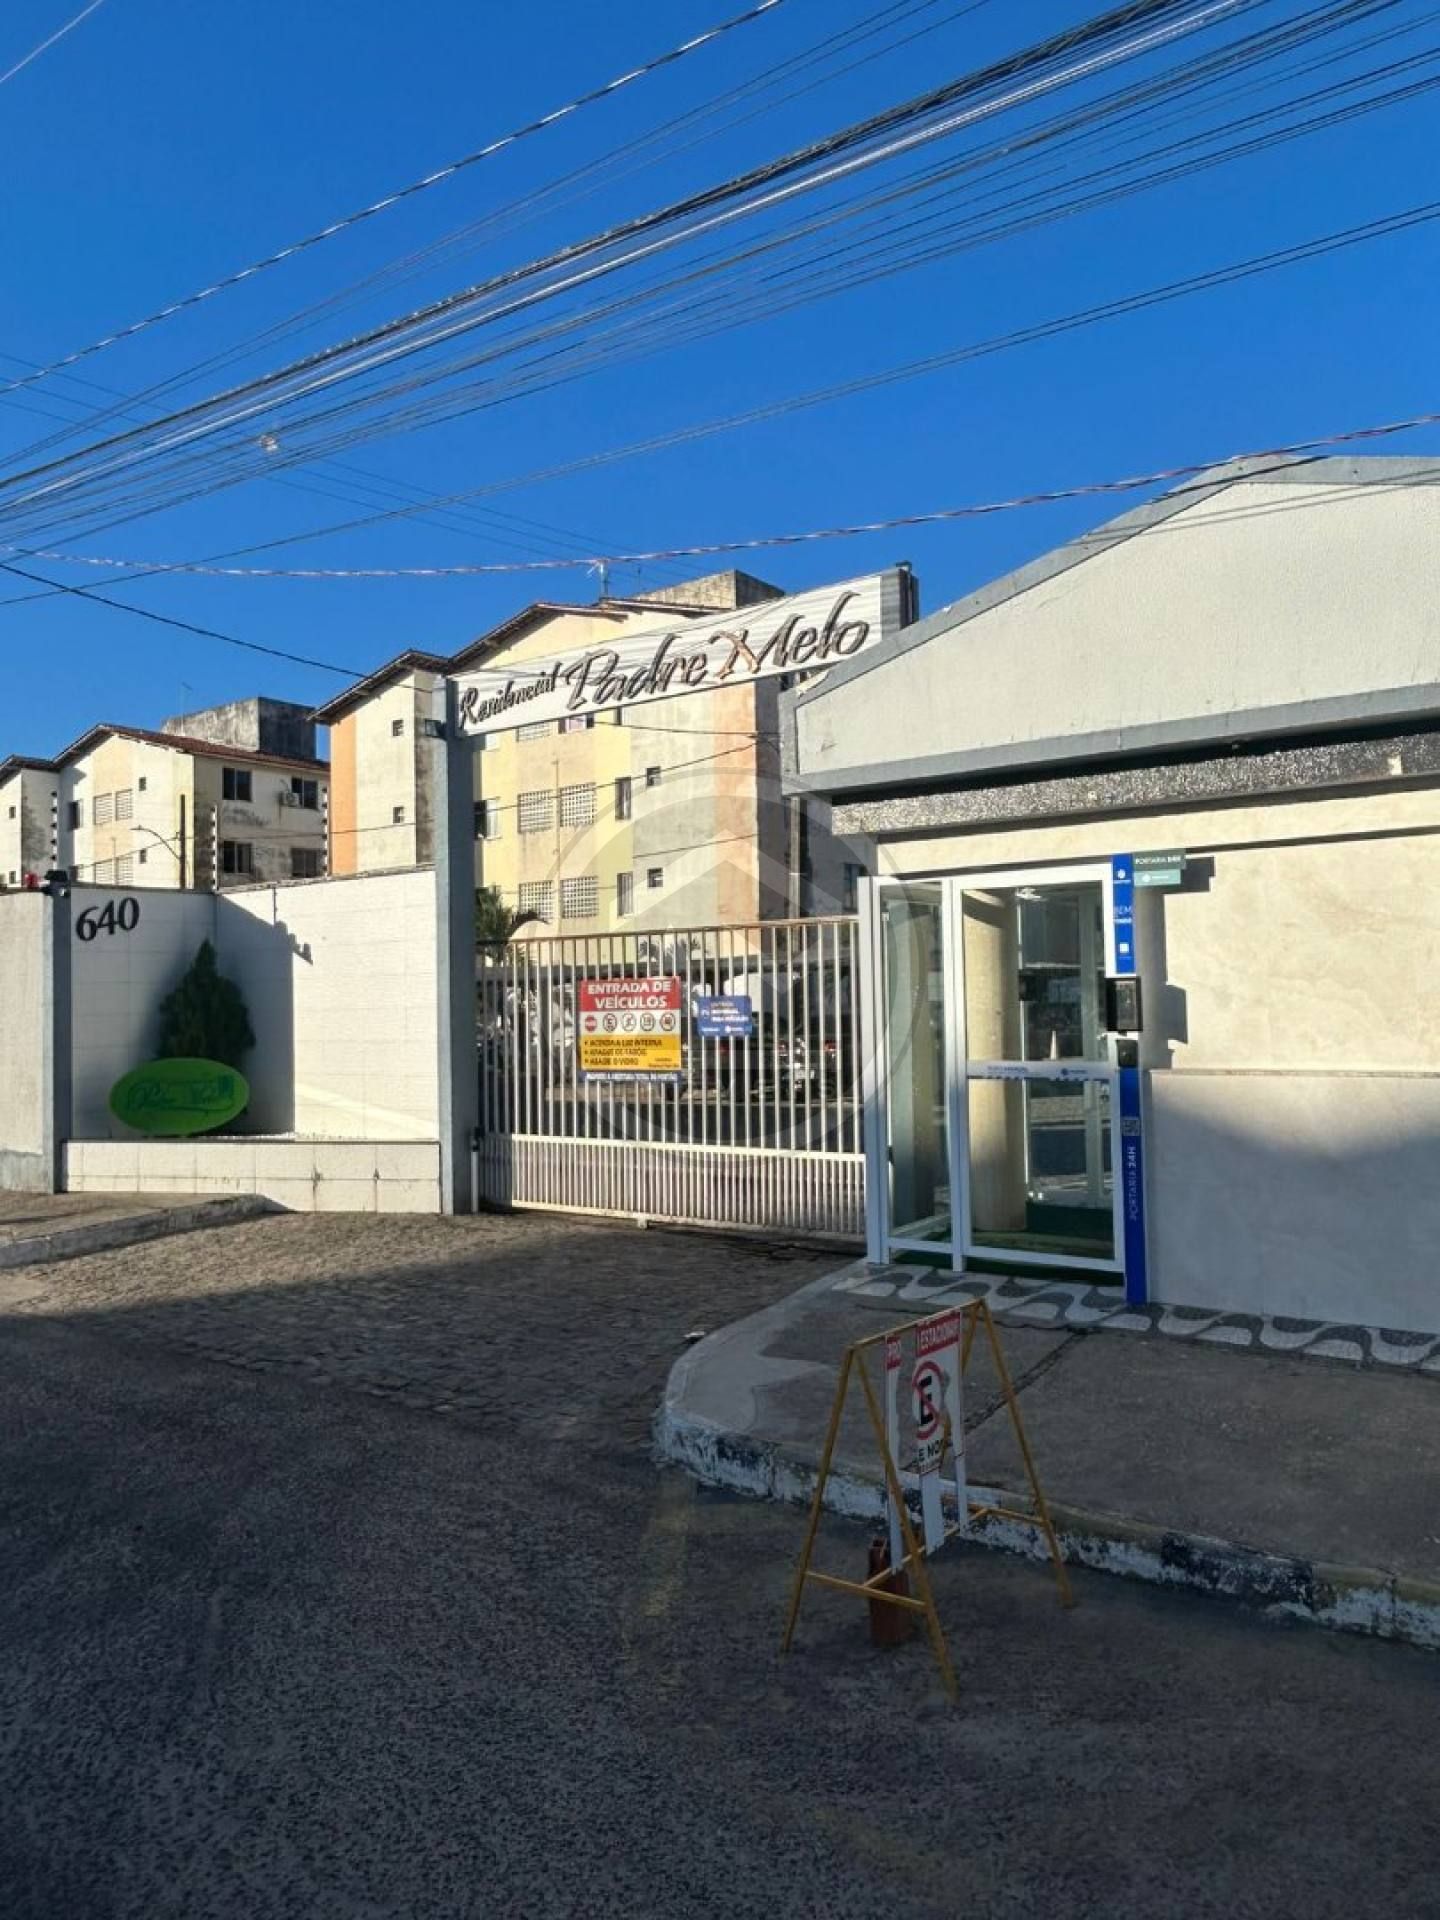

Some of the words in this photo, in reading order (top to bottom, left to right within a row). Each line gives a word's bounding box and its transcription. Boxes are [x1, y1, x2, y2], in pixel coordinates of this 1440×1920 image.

[561, 632, 708, 710] Padre
[709, 591, 870, 681] Melo
[75, 897, 140, 942] 640
[587, 982, 650, 994] ENTRADA
[653, 980, 671, 992] DE
[594, 994, 668, 1009] VEÍCULOS
[1127, 1146, 1137, 1169] 24H
